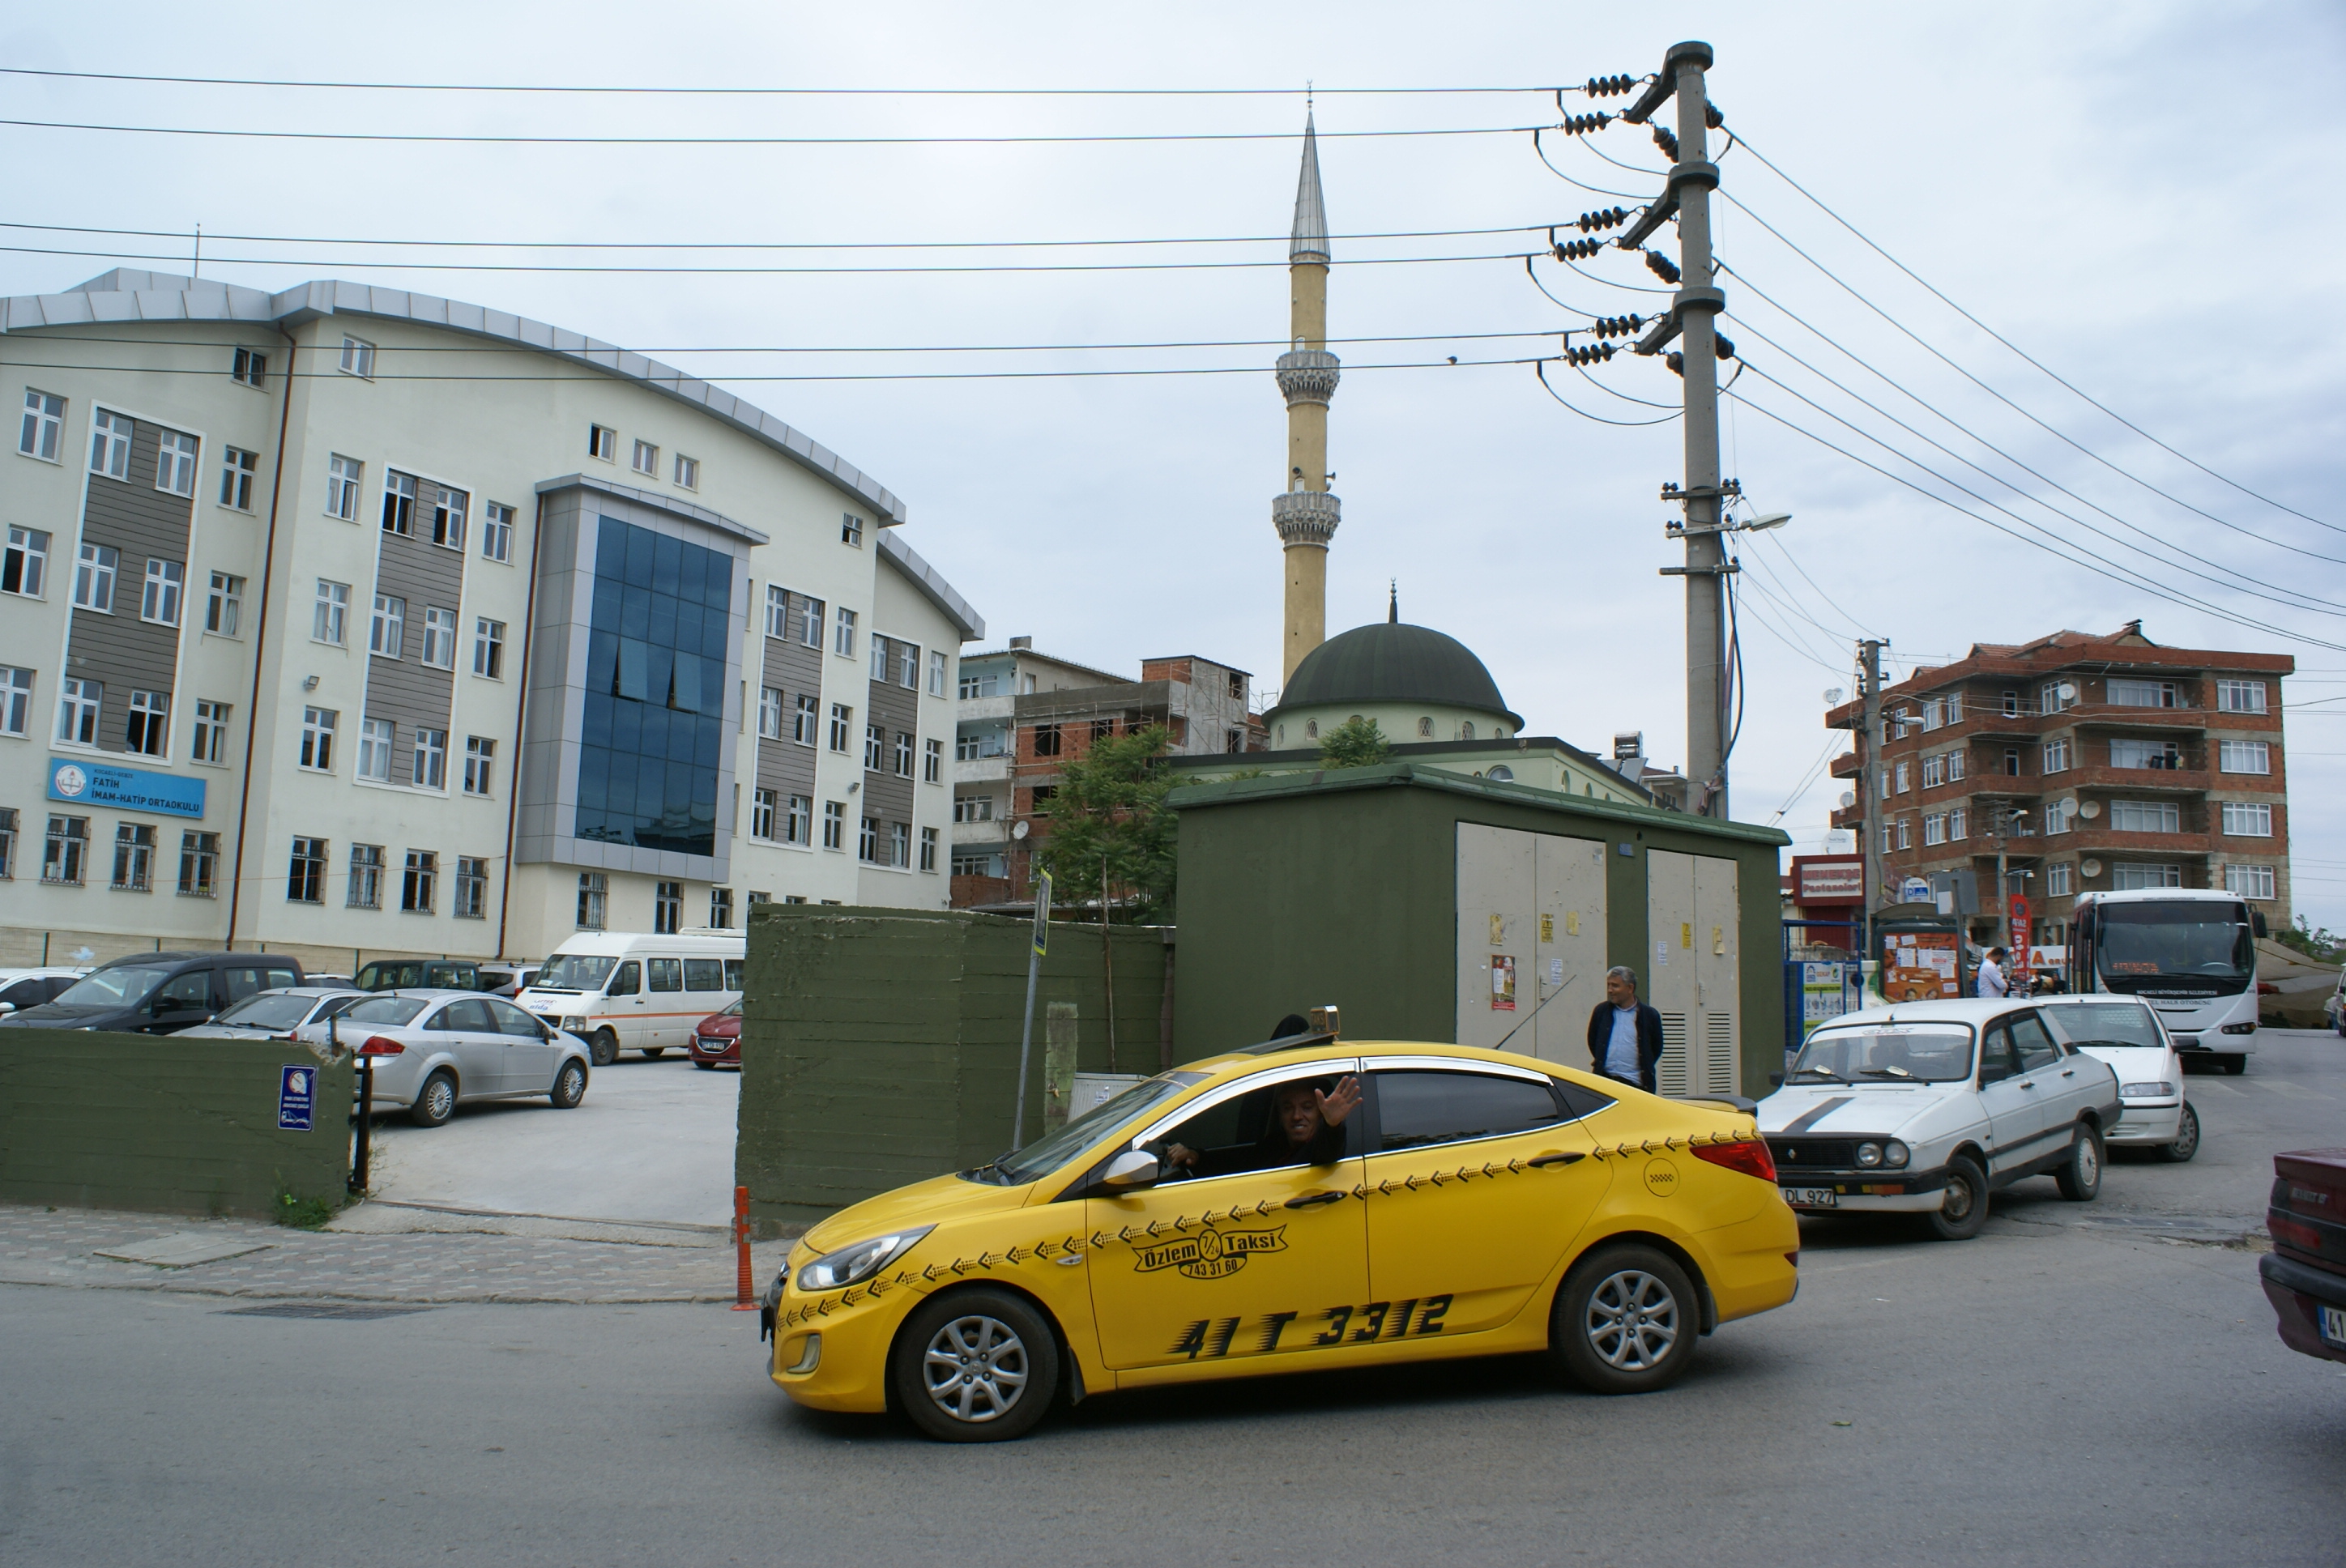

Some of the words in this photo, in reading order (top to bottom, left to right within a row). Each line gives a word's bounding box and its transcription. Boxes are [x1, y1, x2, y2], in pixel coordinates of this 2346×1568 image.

[93, 776, 120, 789] FATİH
[92, 789, 146, 805] İMAM-HATİP
[148, 799, 200, 812] ORTAOKULU
[1802, 869, 1861, 881] MENEKŞE
[1785, 1189, 1805, 1203] DL
[1807, 1190, 1832, 1203] 927
[1145, 1244, 1196, 1268] Özlem
[1225, 1233, 1276, 1251] Taksi
[1188, 1263, 1207, 1276] 743
[1210, 1262, 1222, 1275] 31
[1225, 1259, 1238, 1272] 60
[1165, 1316, 1241, 1359] 41
[1255, 1310, 1299, 1352] T
[1307, 1293, 1454, 1345] 3312
